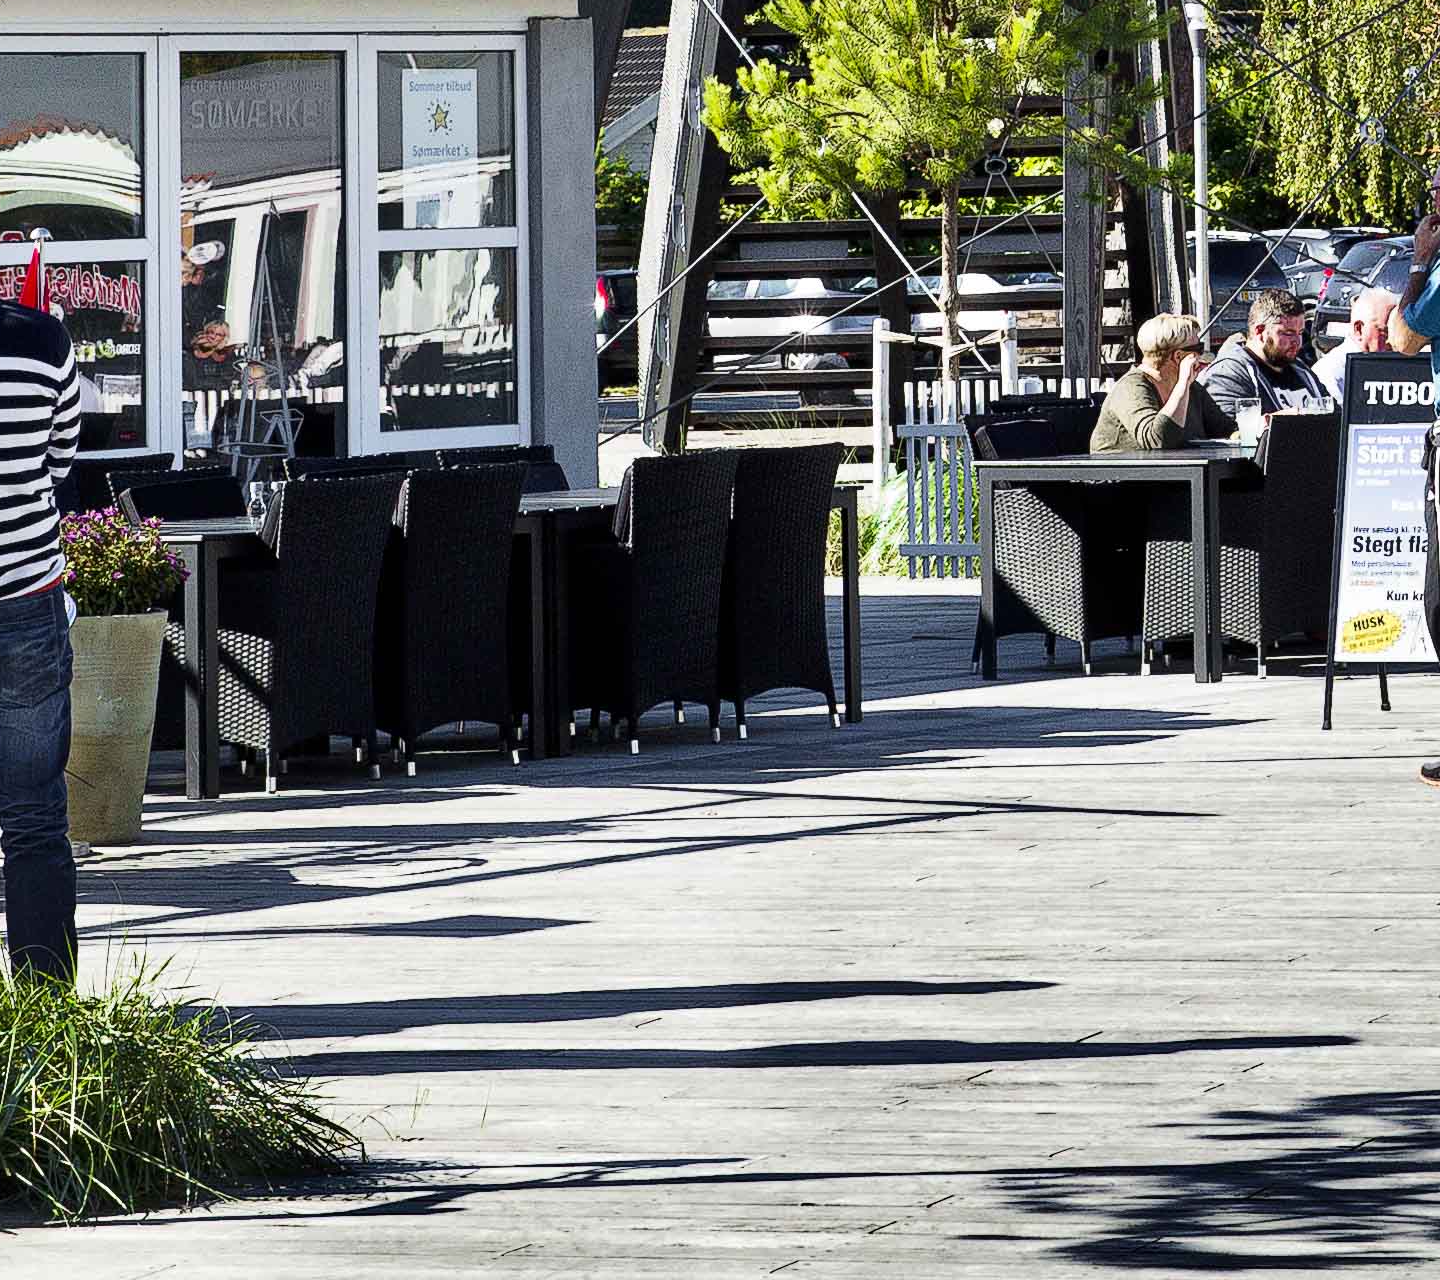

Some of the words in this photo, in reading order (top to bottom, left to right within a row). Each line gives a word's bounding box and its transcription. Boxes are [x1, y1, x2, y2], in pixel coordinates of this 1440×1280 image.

[1363, 381, 1435, 406] TUBO
[1357, 444, 1404, 464] Stort
[1352, 535, 1402, 557] Stegt
[1386, 590, 1409, 601] Kun
[1353, 615, 1386, 632] HUSK
